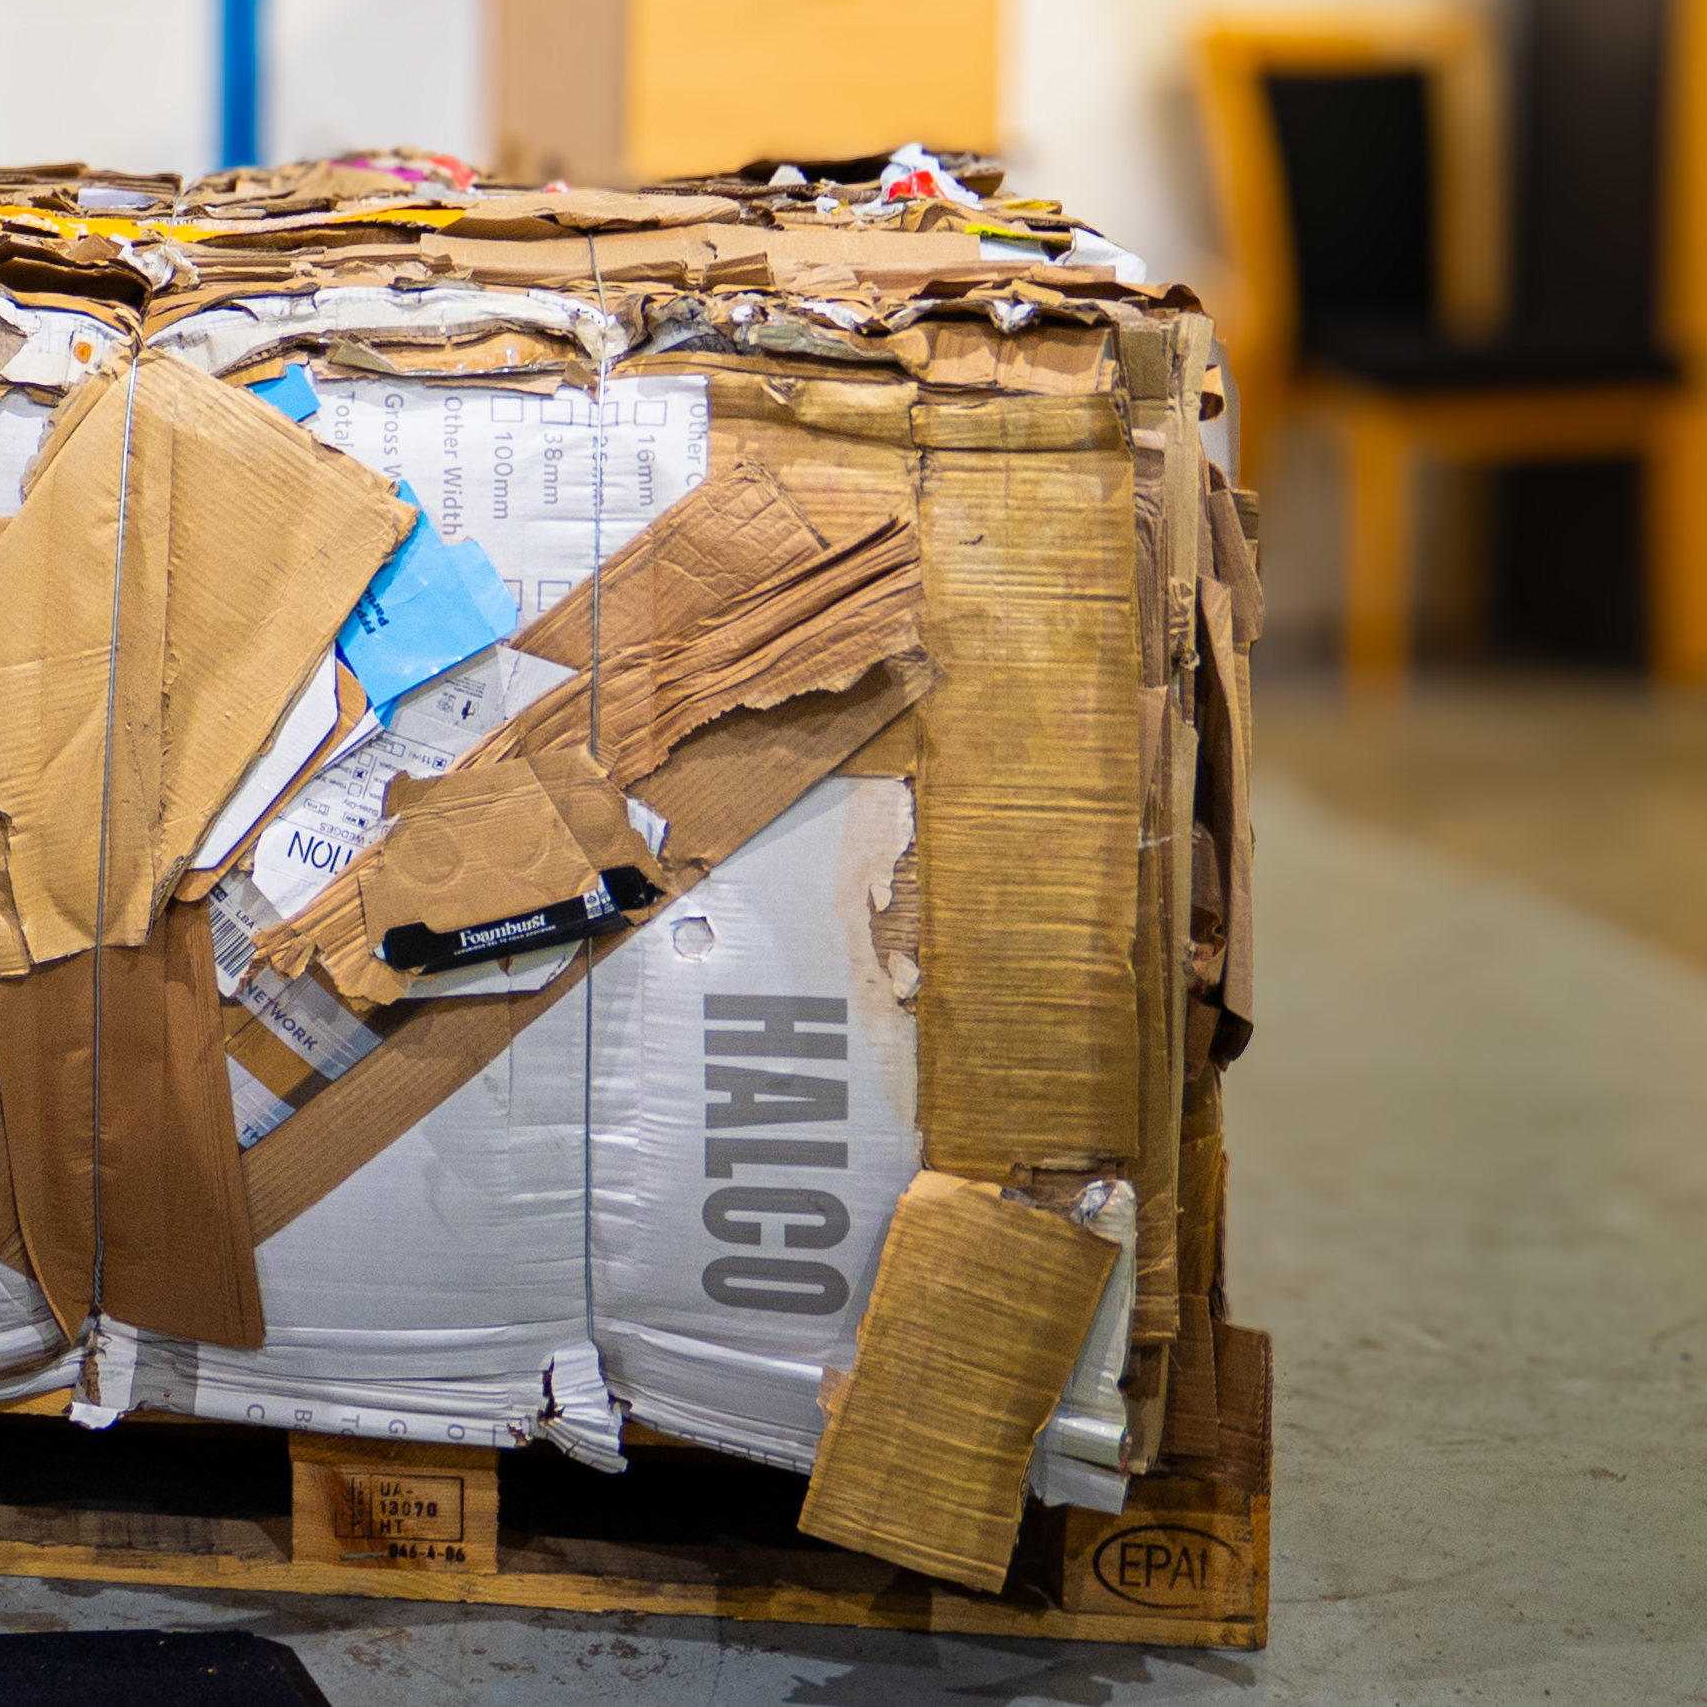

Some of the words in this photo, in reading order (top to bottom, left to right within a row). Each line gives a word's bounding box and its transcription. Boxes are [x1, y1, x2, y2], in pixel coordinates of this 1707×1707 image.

[334, 391, 355, 447] Total
[383, 393, 404, 455] Gross
[444, 396, 464, 459] Other
[687, 403, 708, 465] Other
[493, 432, 514, 520] 100mm
[543, 433, 563, 505] 38mm
[637, 434, 656, 506] 16mm
[442, 467, 463, 536] Width
[319, 822, 365, 845] WEDGES
[236, 910, 255, 930] LBA
[459, 913, 547, 948] Foamburst
[247, 984, 318, 1052] NETWORK
[701, 993, 851, 1316] HALCO
[380, 1518, 405, 1535] HT
